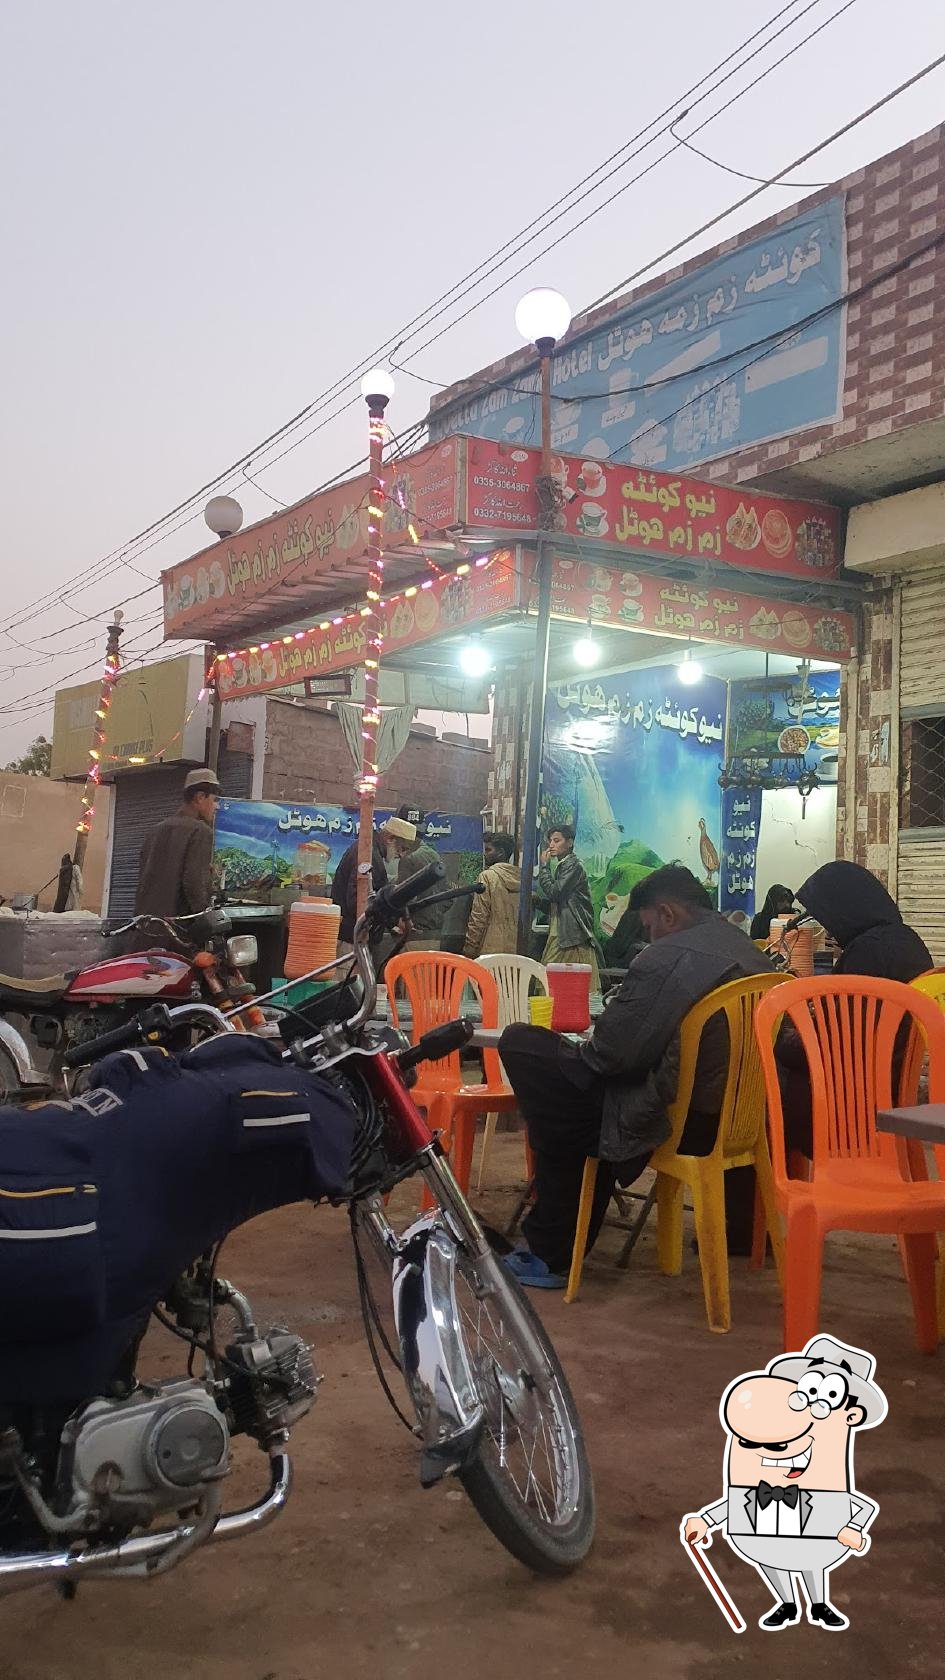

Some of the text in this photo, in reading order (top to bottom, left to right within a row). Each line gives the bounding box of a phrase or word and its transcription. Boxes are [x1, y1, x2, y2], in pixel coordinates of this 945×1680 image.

[552, 341, 593, 387] Hotel
[685, 490, 716, 518] نیو
[668, 520, 692, 551] زم
[698, 526, 721, 556] زم
[699, 616, 720, 636] زم
[725, 620, 744, 639] زم
[633, 698, 654, 730] زم
[697, 713, 722, 745] نیو
[732, 795, 751, 817] نیو
[425, 819, 452, 838] نیو
[727, 849, 755, 870] زم زم
